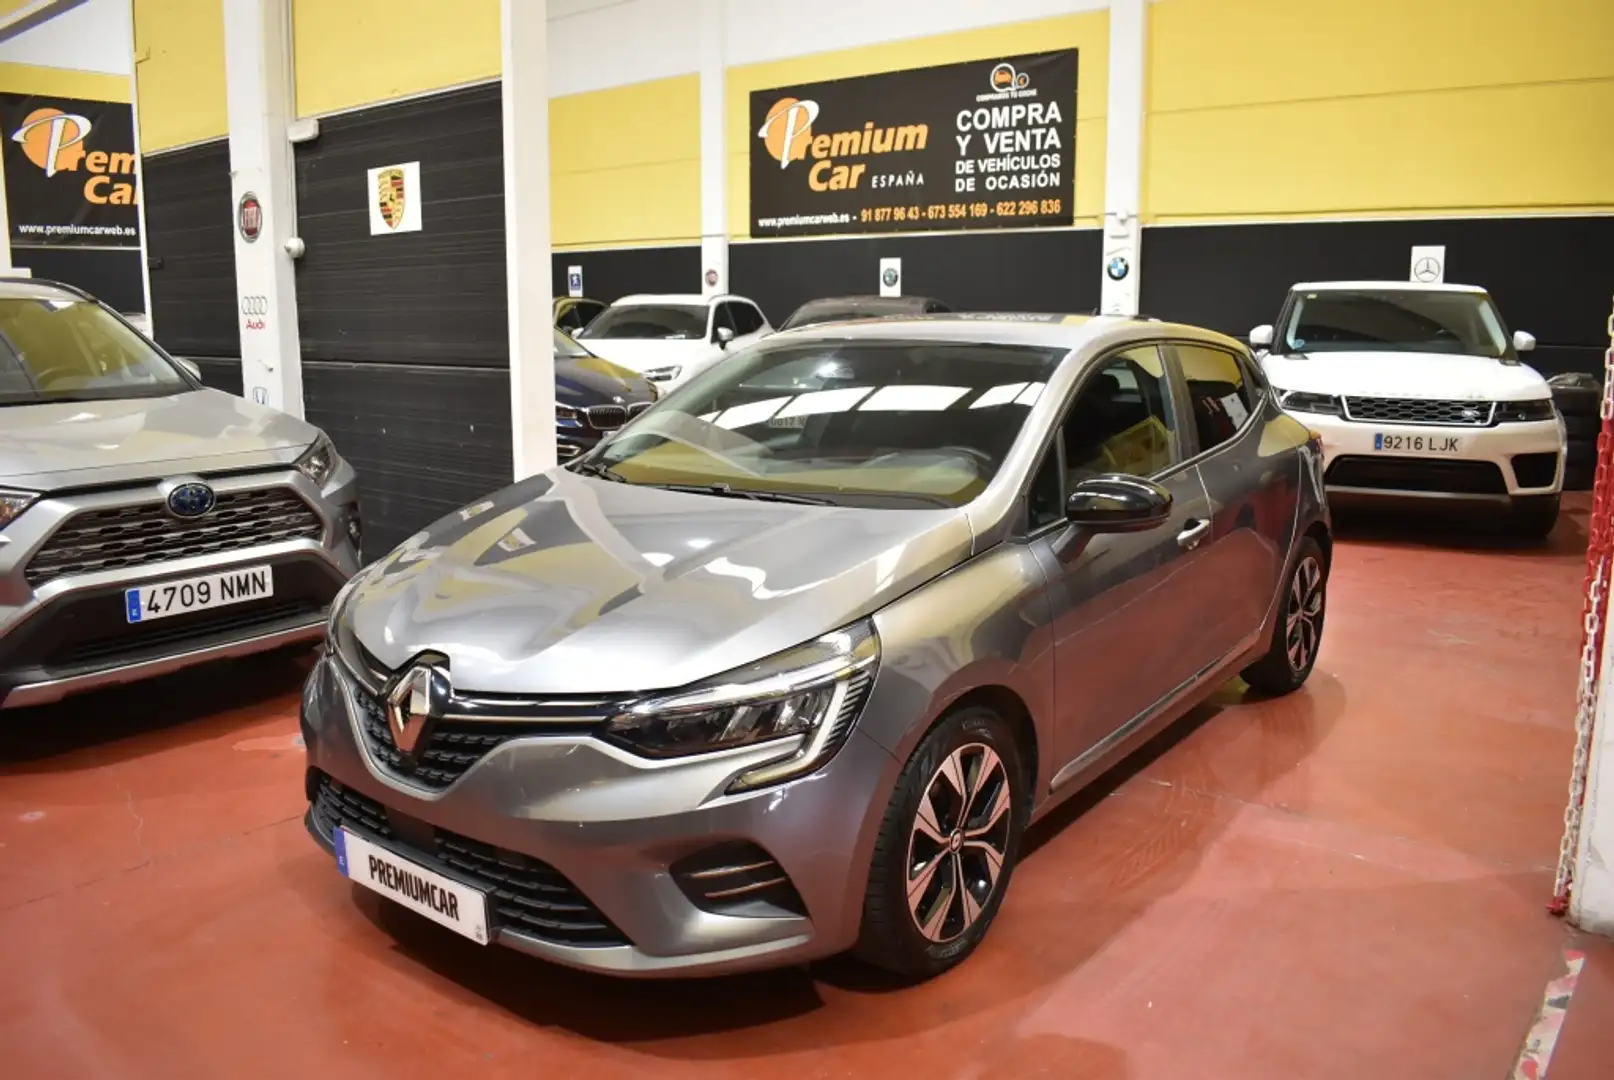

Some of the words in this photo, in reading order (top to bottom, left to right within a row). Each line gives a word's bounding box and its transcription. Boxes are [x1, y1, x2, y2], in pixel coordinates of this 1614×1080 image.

[956, 101, 1062, 132] COMPRA
[758, 99, 928, 169] Premium
[956, 134, 972, 156] Y
[983, 127, 1061, 154] VENTA
[808, 160, 866, 192] Car
[871, 170, 924, 188] ESPAÑA
[955, 160, 975, 175] DE
[977, 153, 1061, 173] VEHÍCULOS
[955, 178, 975, 192] DE
[985, 169, 1060, 190] OCASIÓN
[758, 212, 850, 228] www.premiumcarweb.es
[861, 208, 872, 223] 91
[874, 207, 892, 222] 877
[893, 206, 906, 221] 96
[907, 206, 920, 220] 43
[927, 204, 946, 219] 673
[948, 203, 966, 219] 554
[969, 202, 988, 217] 169
[996, 201, 1017, 216] 622
[1018, 200, 1039, 215] 296
[1040, 199, 1061, 214] 836
[18, 224, 136, 236] www.premiumcarweb.es
[1384, 435, 1424, 450] 9216
[1428, 437, 1459, 452] LJK
[147, 581, 211, 613] 4709
[221, 571, 266, 600] NMN
[368, 854, 460, 921] PREMIUMCAR
